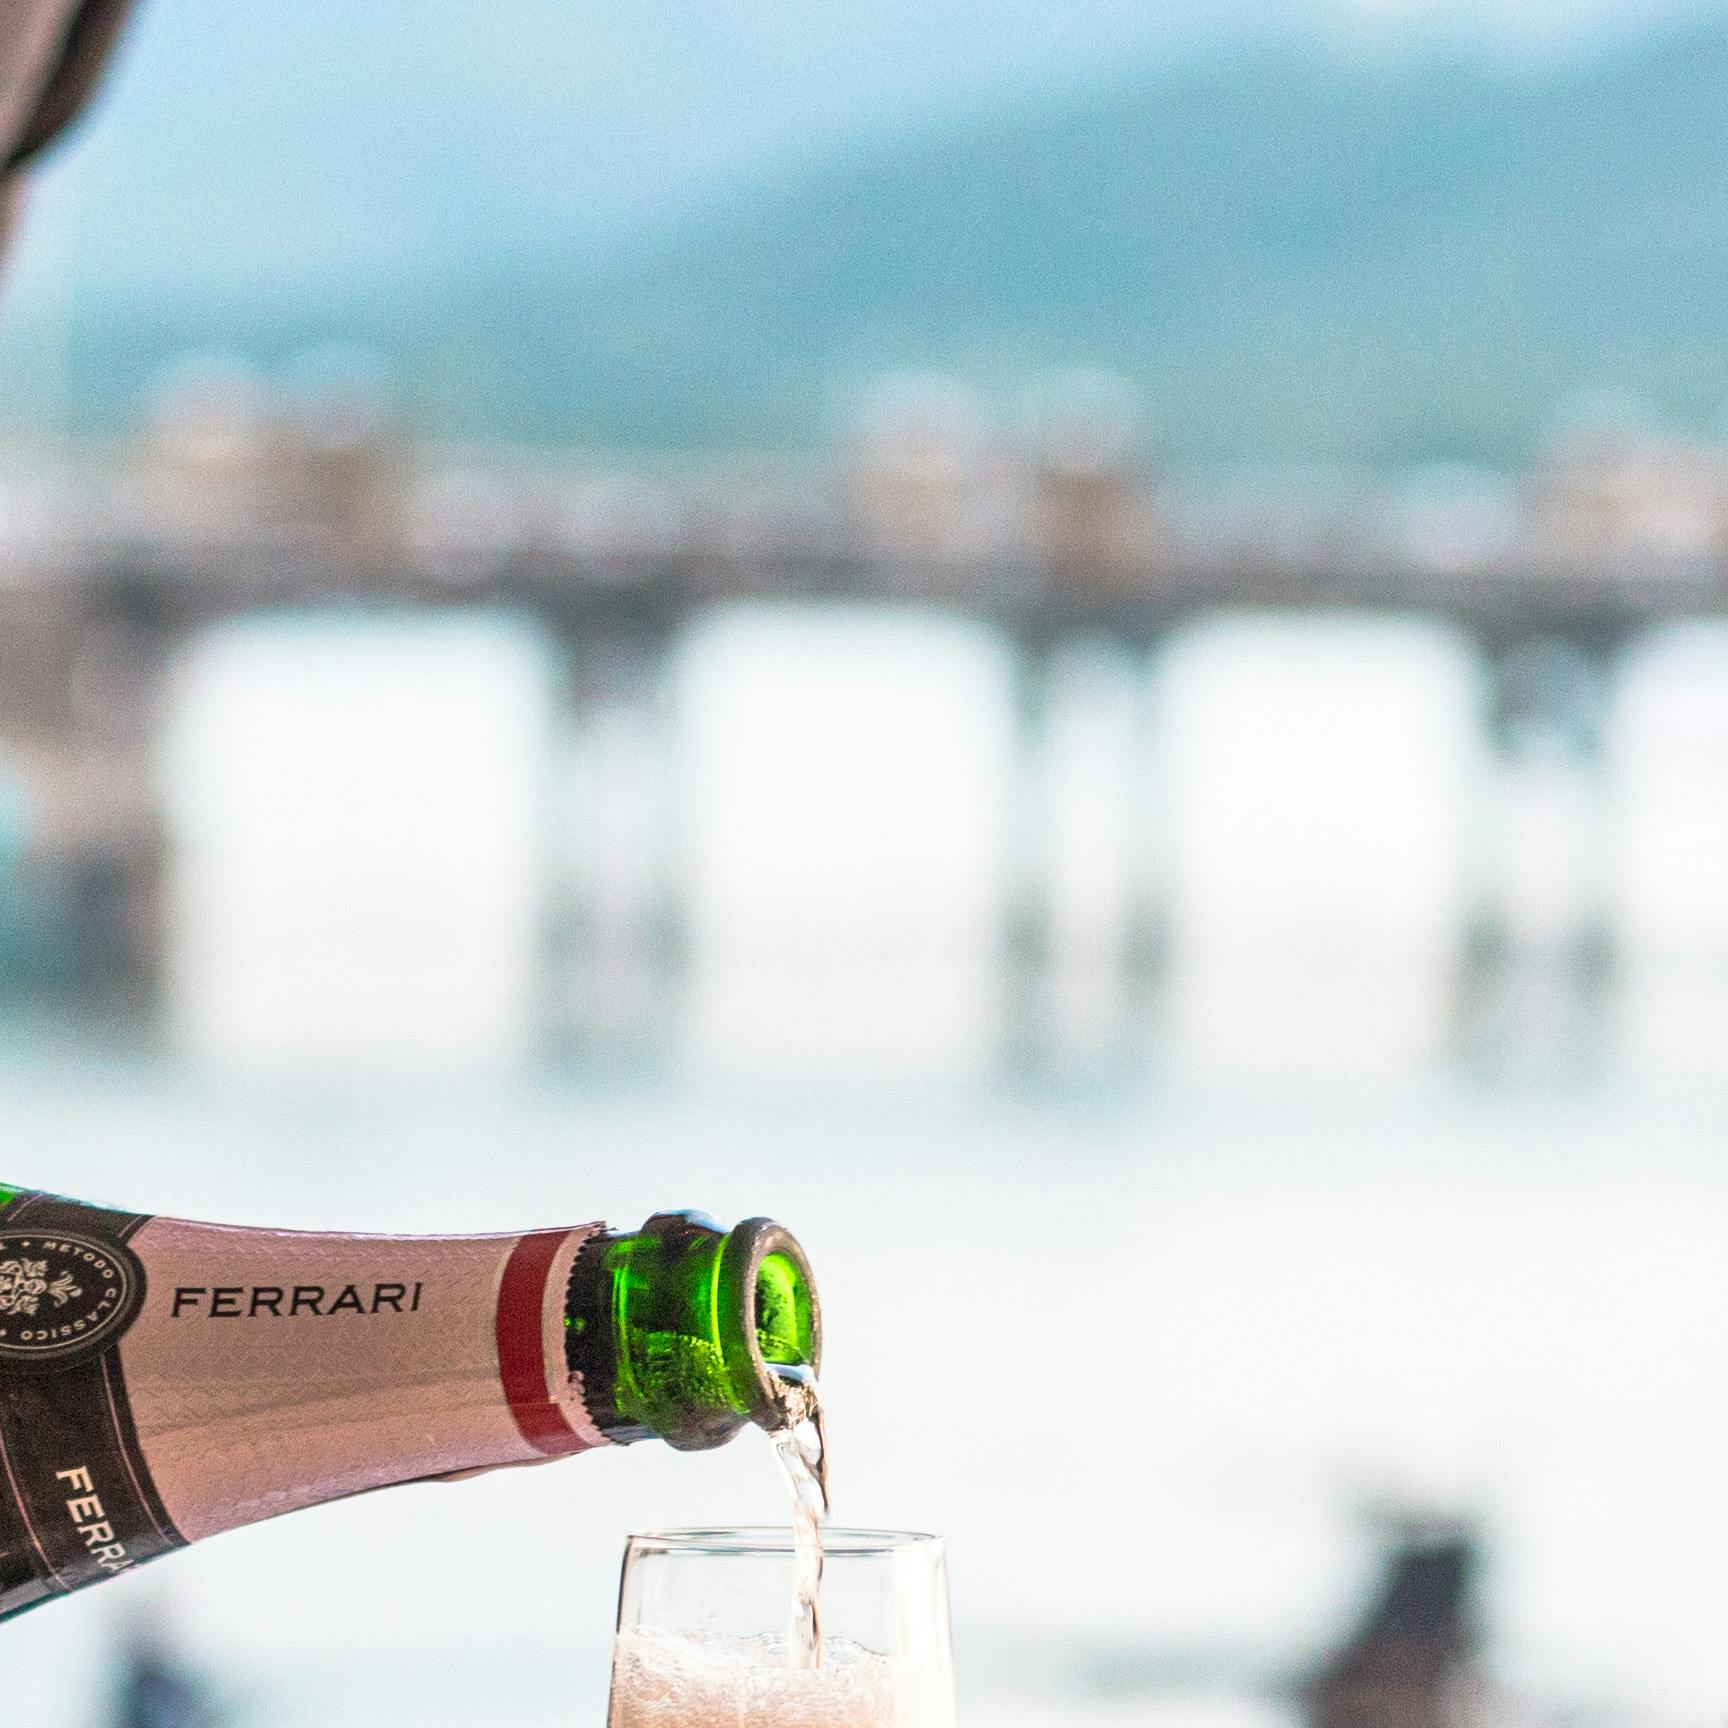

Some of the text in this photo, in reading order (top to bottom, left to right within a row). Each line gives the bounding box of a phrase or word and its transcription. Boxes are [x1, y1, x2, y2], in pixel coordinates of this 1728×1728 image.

[20, 1240, 118, 1341] METODO CLASSICO
[170, 1281, 425, 1320] FERRARI
